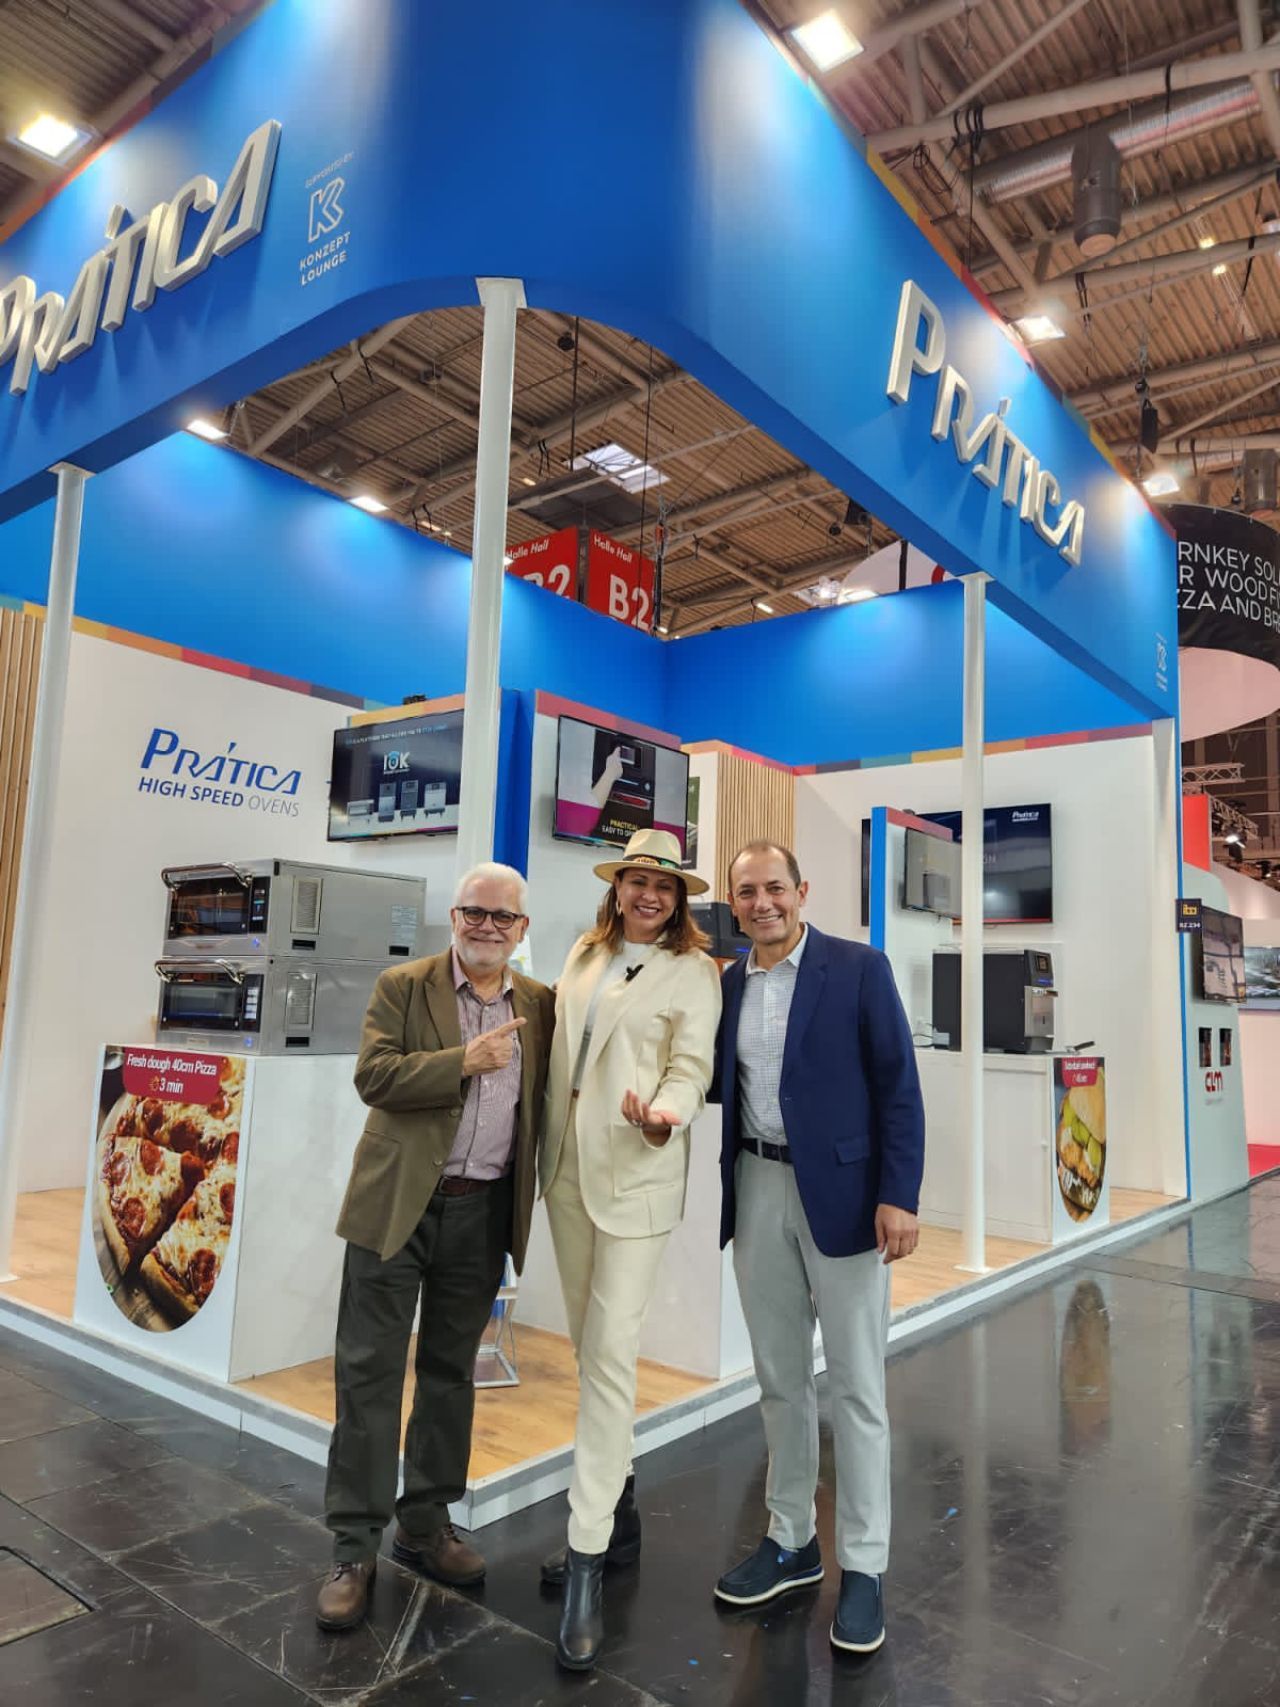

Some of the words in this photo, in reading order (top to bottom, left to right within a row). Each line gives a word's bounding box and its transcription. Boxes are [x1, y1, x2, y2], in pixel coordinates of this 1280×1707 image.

[299, 231, 351, 271] KONZEPT
[301, 250, 348, 286] LOUNGE
[531, 539, 549, 554] Hall
[594, 536, 615, 555] Halle
[616, 549, 633, 564] Hall
[1204, 567, 1268, 600] WOOD
[609, 574, 650, 633] B2
[1176, 588, 1216, 611] ZA
[1219, 594, 1262, 621] AND
[140, 728, 302, 795] PRÁTICA
[138, 776, 187, 799] HIGH
[190, 785, 245, 807] SPEED
[247, 795, 300, 818] OVENS
[127, 1053, 147, 1068] Fresh
[147, 1056, 171, 1074] dough
[171, 1058, 194, 1075] 40cm
[194, 1060, 218, 1077] Pizza
[159, 1077, 166, 1092] 3
[166, 1079, 184, 1094] min
